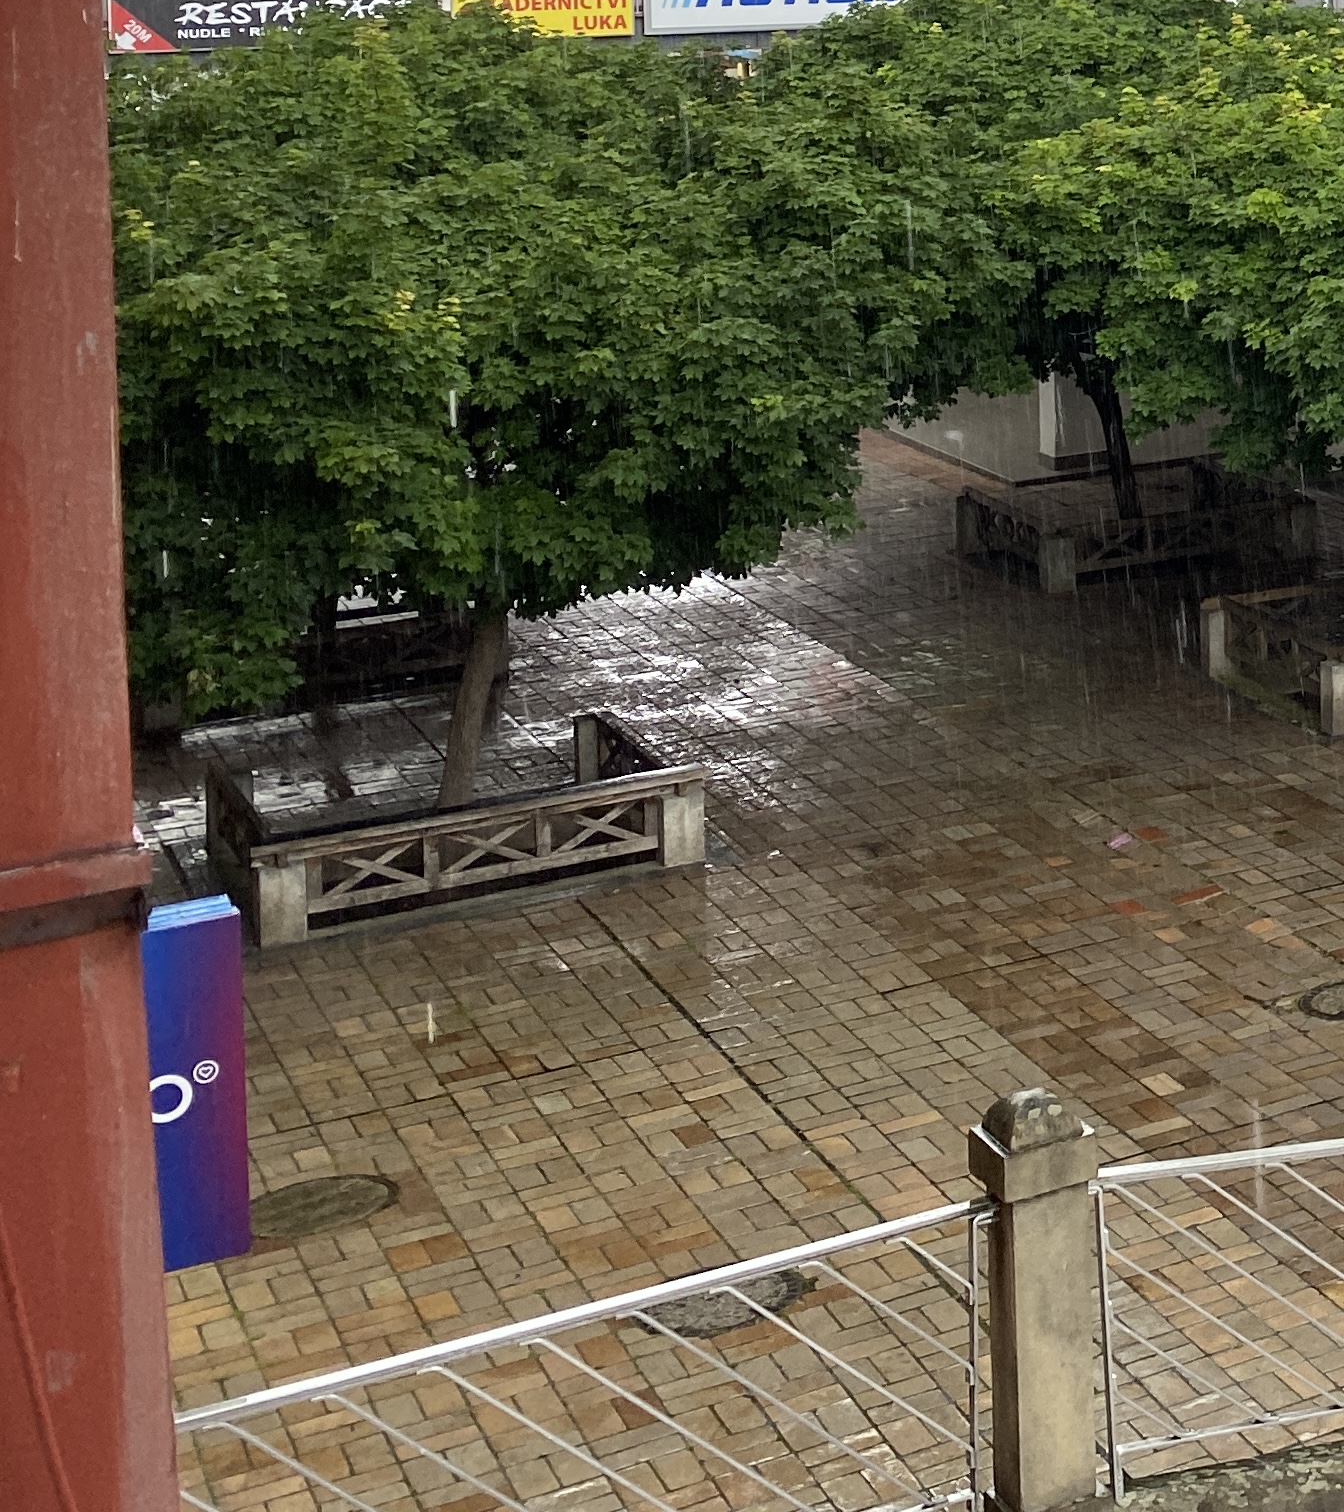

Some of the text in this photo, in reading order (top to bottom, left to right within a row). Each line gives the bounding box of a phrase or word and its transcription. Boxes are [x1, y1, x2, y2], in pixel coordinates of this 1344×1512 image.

[123, 18, 152, 44] 20M
[573, 14, 627, 31] LUKA
[178, 28, 230, 39] NUDLE
